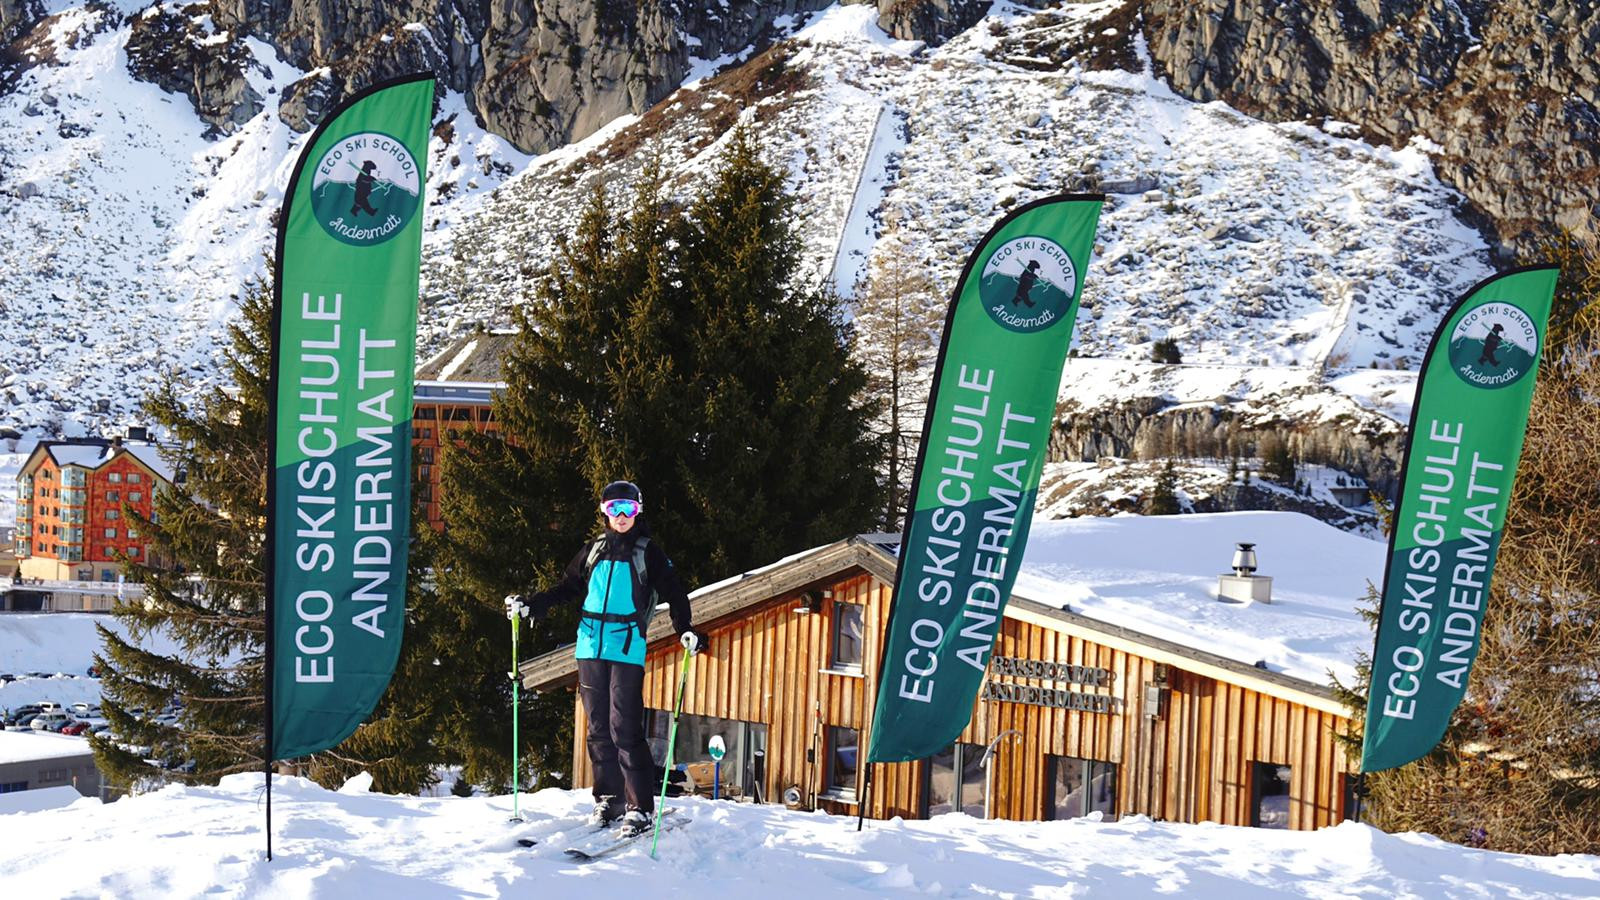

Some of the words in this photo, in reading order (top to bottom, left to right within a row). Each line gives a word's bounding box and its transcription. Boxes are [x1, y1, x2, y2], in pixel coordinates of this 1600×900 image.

[321, 150, 343, 176] ECO
[345, 138, 367, 153] SKI
[372, 138, 415, 179] SCHOOL
[329, 213, 402, 240] Andermatt
[991, 247, 1012, 268] ECO
[1015, 240, 1036, 251] SKI
[1039, 242, 1073, 282] SCHOOL
[992, 304, 1055, 328] Andermatt
[1458, 313, 1478, 332] ECO
[1480, 306, 1499, 316] SKI
[1502, 307, 1535, 342] SCHOOL
[1460, 364, 1519, 385] Andermatt
[295, 292, 342, 572] SKISCHULE
[351, 328, 397, 638] ANDERMATT
[918, 364, 995, 606] SKISCHULE
[956, 402, 1036, 672] ANDERMATT
[1398, 419, 1463, 635] SKISCHULE
[1436, 451, 1503, 689] ANDERMATT
[295, 590, 334, 683] ECO
[898, 618, 944, 703] ECO
[990, 655, 1108, 686] BASECAMP
[981, 679, 1112, 715] ANDERMATT
[1383, 645, 1424, 720] ECO
